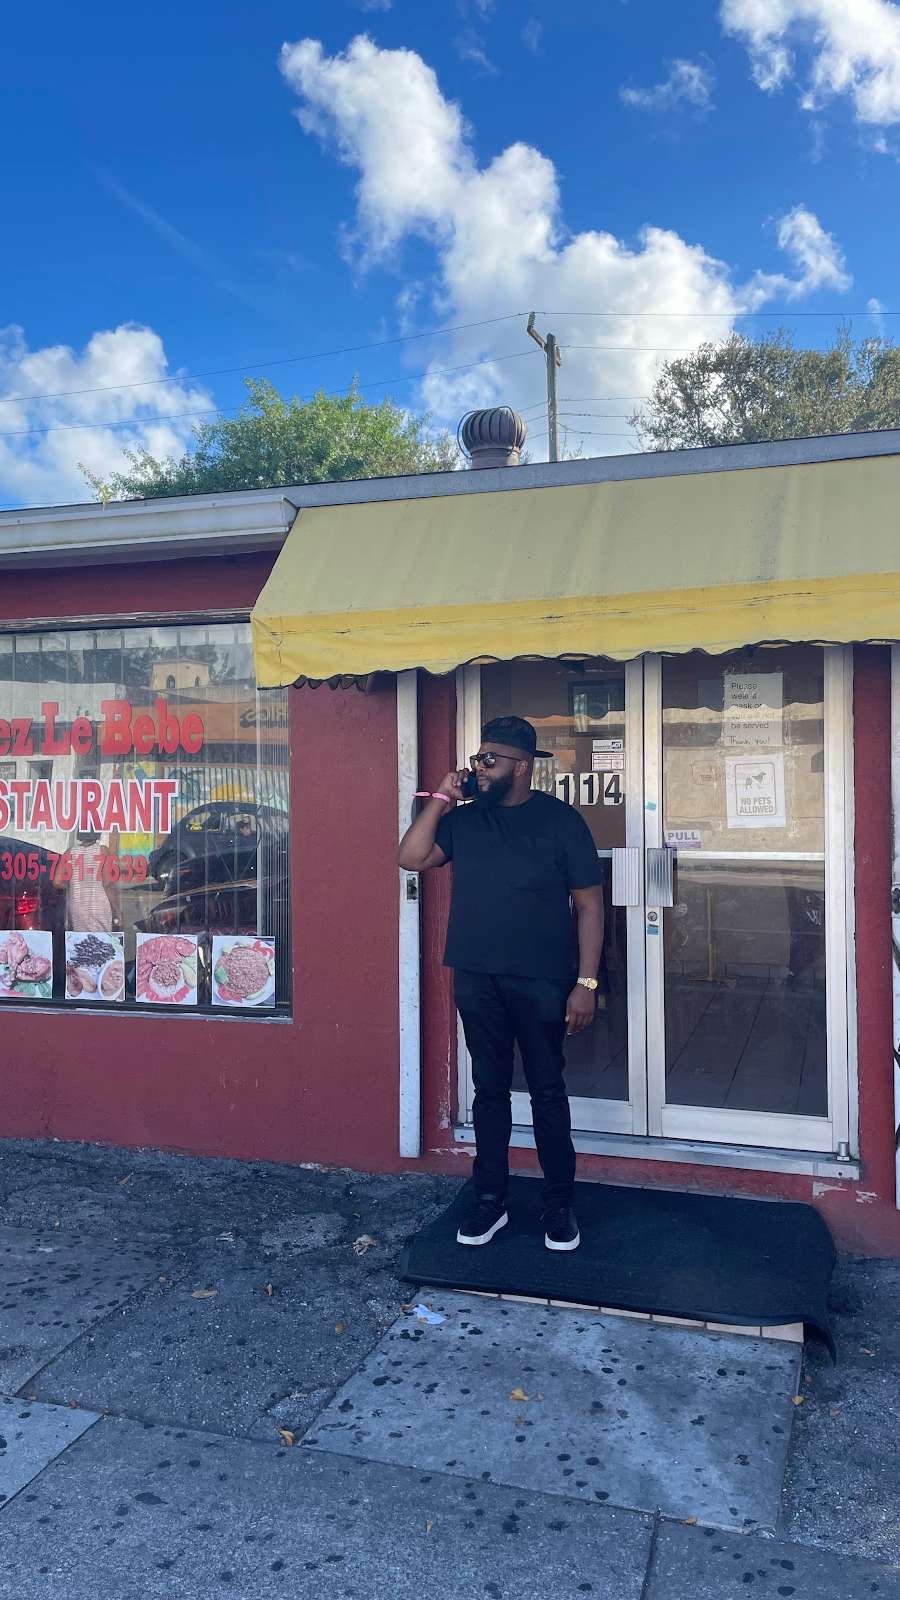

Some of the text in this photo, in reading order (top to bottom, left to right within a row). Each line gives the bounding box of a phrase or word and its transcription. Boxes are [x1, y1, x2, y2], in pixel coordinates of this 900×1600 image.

[41, 702, 94, 756] Le
[100, 698, 205, 755] Bebe
[741, 797, 772, 805] NO PETS
[739, 806, 774, 814] ALLOWED
[667, 831, 699, 841] PULL
